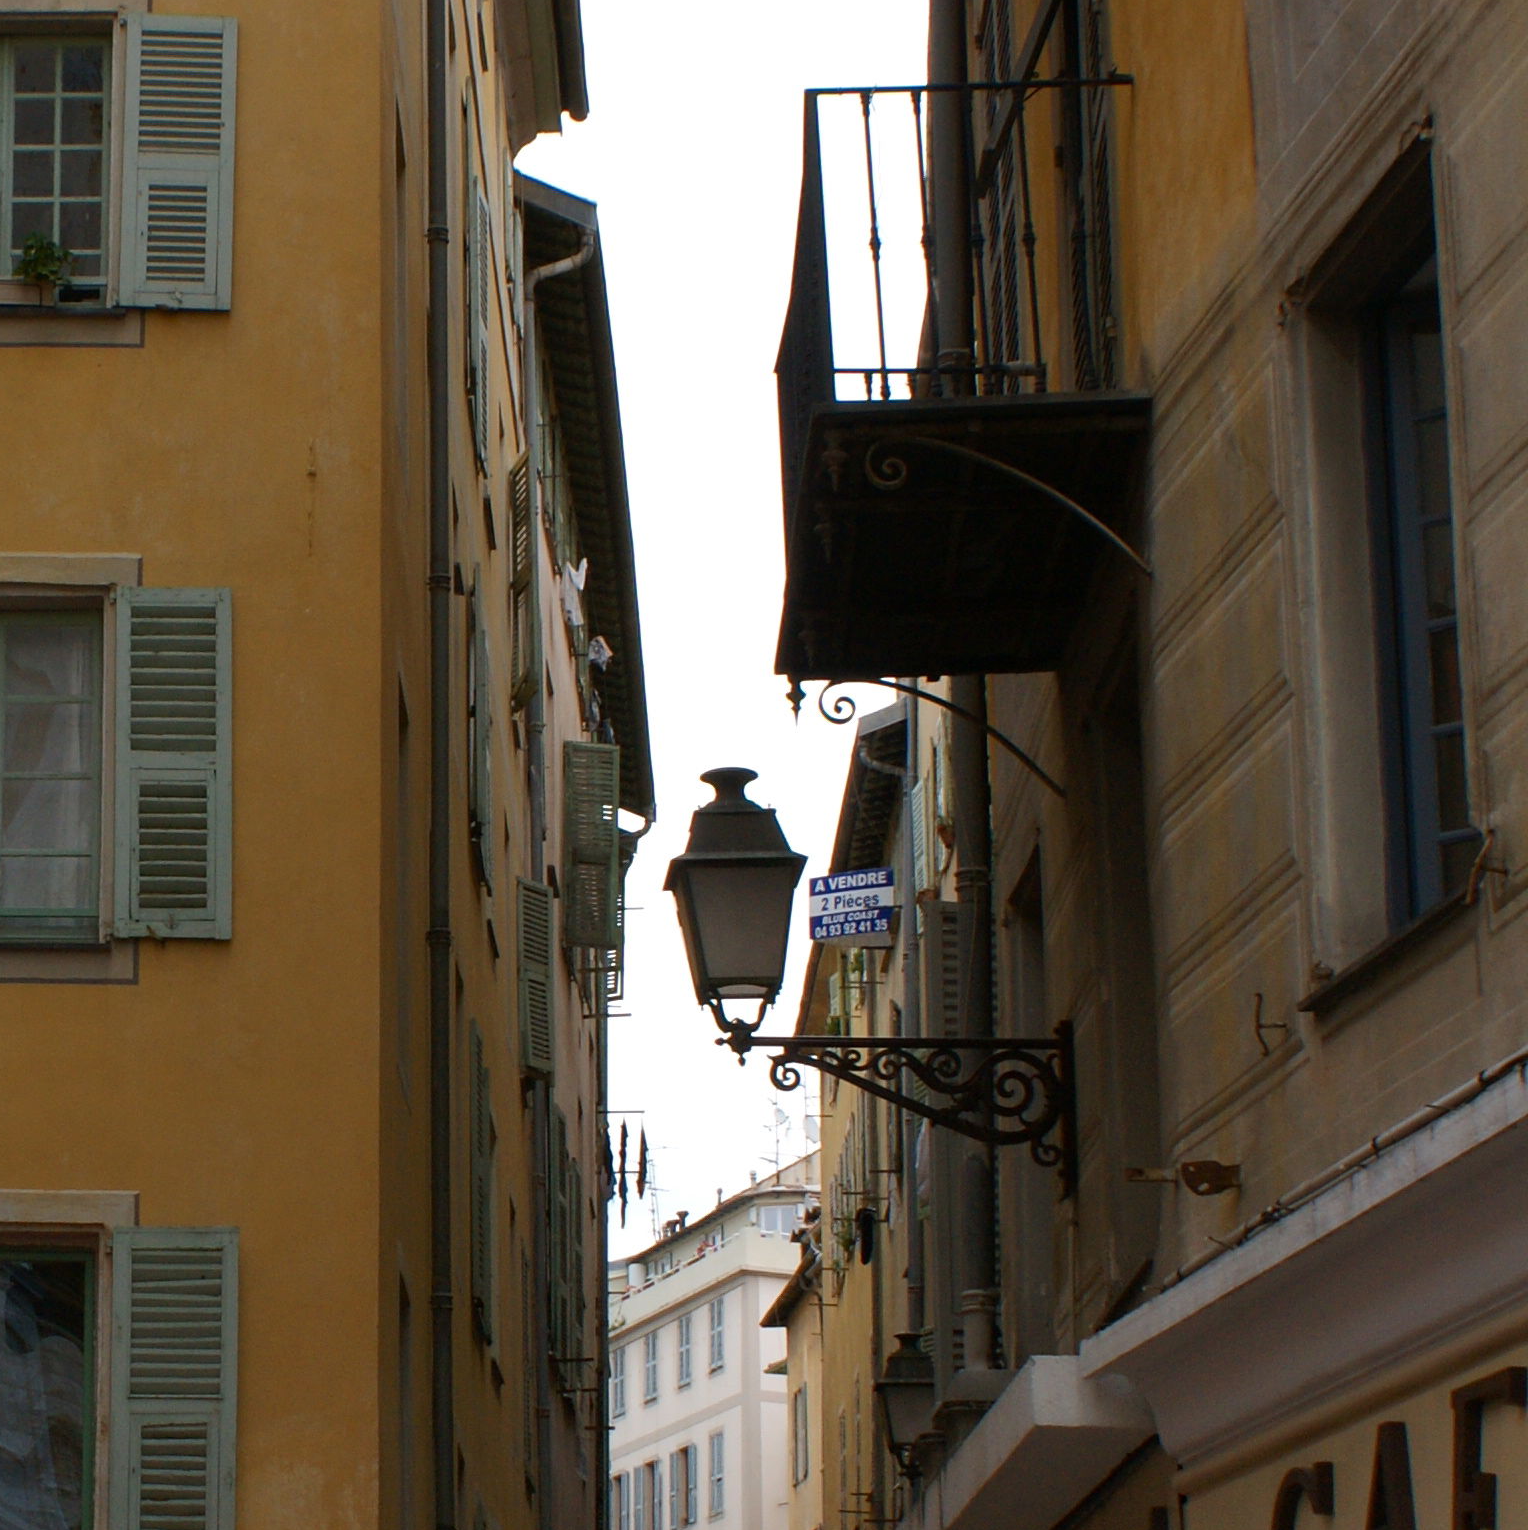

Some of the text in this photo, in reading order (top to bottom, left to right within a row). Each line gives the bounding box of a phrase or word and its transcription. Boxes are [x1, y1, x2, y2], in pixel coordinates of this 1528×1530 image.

[814, 872, 887, 893] A VENDRE
[821, 893, 880, 912] 2 Pièces
[822, 910, 879, 925] BLUE COAST
[814, 925, 828, 939] 04
[829, 923, 842, 937] 93
[858, 920, 871, 933] 41
[874, 918, 888, 932] 35
